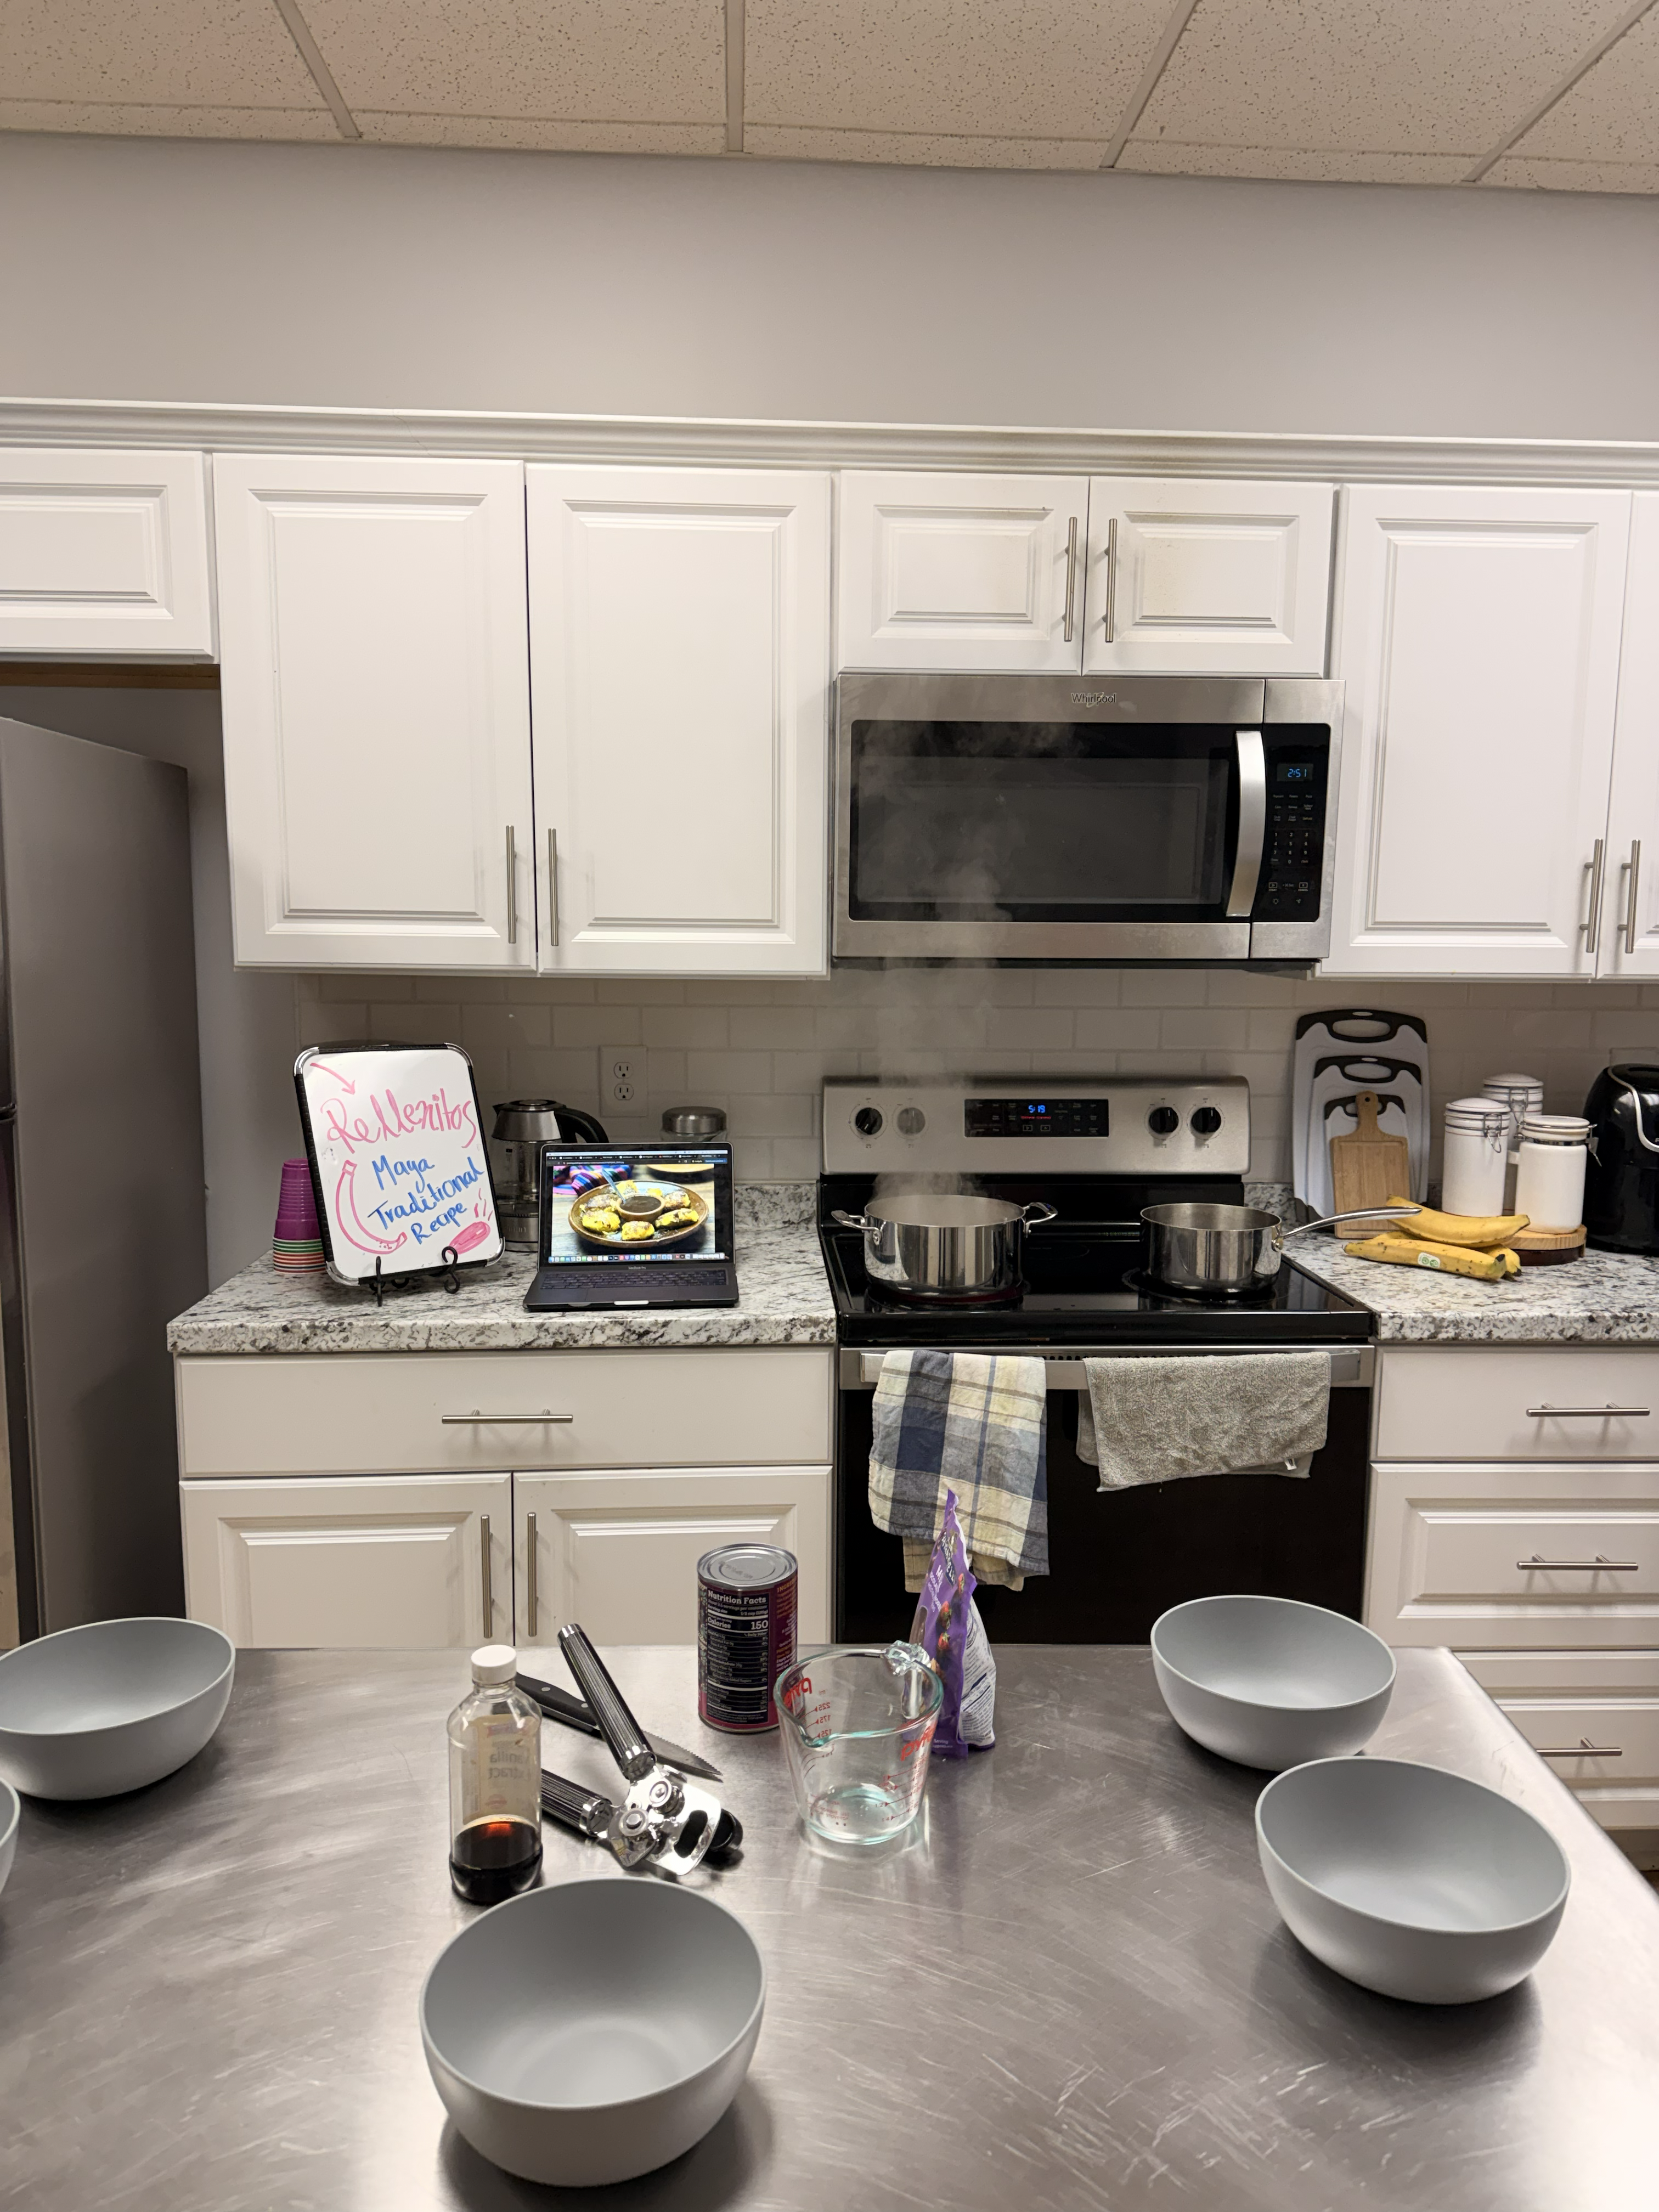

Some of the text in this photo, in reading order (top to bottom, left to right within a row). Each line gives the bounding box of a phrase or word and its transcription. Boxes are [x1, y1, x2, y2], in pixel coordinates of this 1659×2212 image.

[1071, 692, 1116, 706] Whirlpool
[1288, 769, 1307, 778] 2:51
[320, 1088, 477, 1154] Rellenitos
[371, 1155, 435, 1194] Maya
[367, 1156, 485, 1230] Traditional
[410, 1202, 468, 1244] Recipe
[708, 1590, 742, 1604] Nutrition
[708, 1617, 731, 1629] Calories
[751, 1620, 768, 1630] 150
